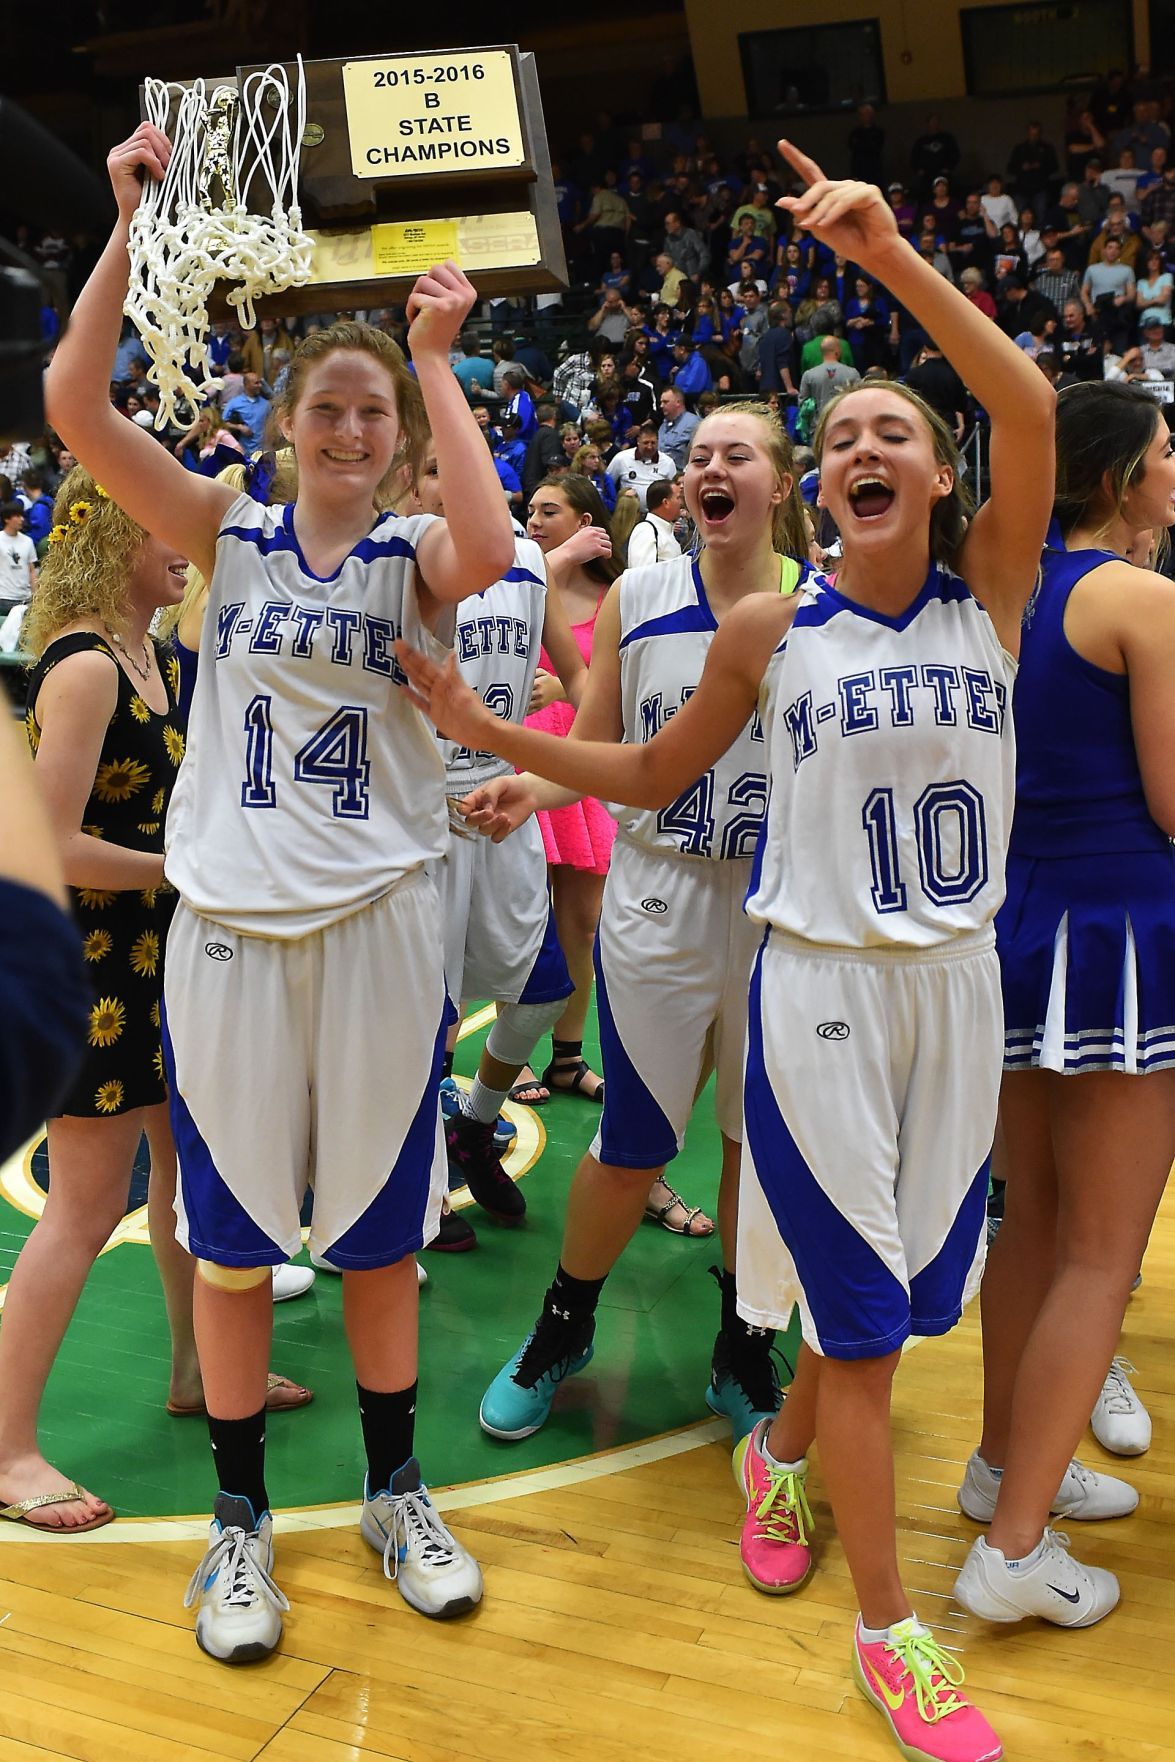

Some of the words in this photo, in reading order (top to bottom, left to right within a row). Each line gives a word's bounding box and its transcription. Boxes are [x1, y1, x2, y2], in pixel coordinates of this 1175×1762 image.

[373, 64, 485, 88] 2015-2016
[424, 92, 440, 109] B
[399, 115, 473, 136] STATE
[366, 138, 510, 165] CHAMPIONS
[240, 694, 371, 820] 14
[657, 768, 767, 860] 42
[862, 779, 988, 915] 10
